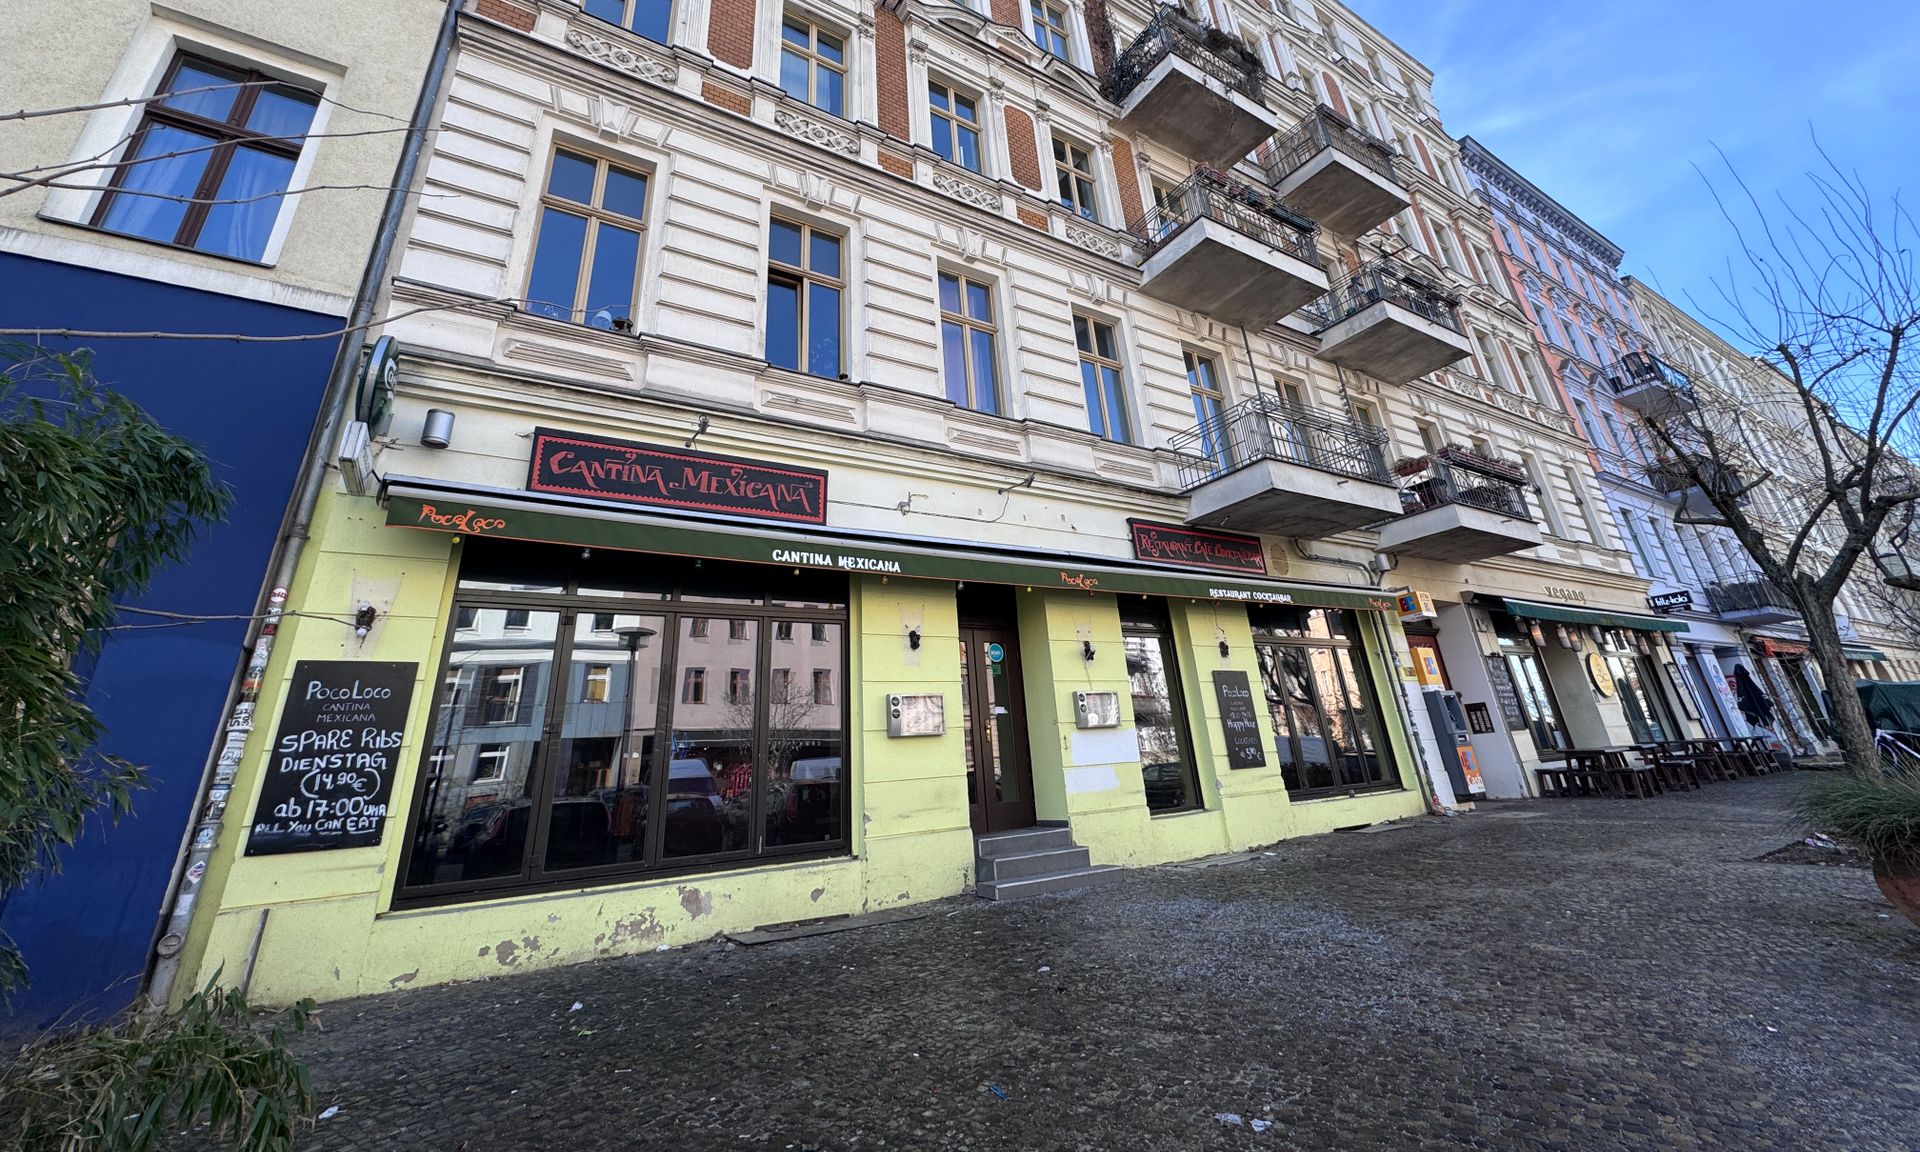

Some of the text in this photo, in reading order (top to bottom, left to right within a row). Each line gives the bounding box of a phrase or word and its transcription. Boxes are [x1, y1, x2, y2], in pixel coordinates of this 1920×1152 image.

[550, 451, 813, 514] CANTINA MEXICANA
[772, 549, 901, 573] CANTINA MEXICANA
[1209, 589, 1293, 604] RESTAURANT COCKTAILBAR
[1654, 594, 1688, 606] fritz-kola
[322, 702, 371, 712] CANTINA
[316, 713, 376, 723] MEXICANA
[279, 729, 353, 753] SPARE
[280, 752, 387, 773] DIENSTAG
[274, 797, 301, 818] ab
[306, 796, 364, 819] 17:00
[347, 817, 379, 831] EAT
